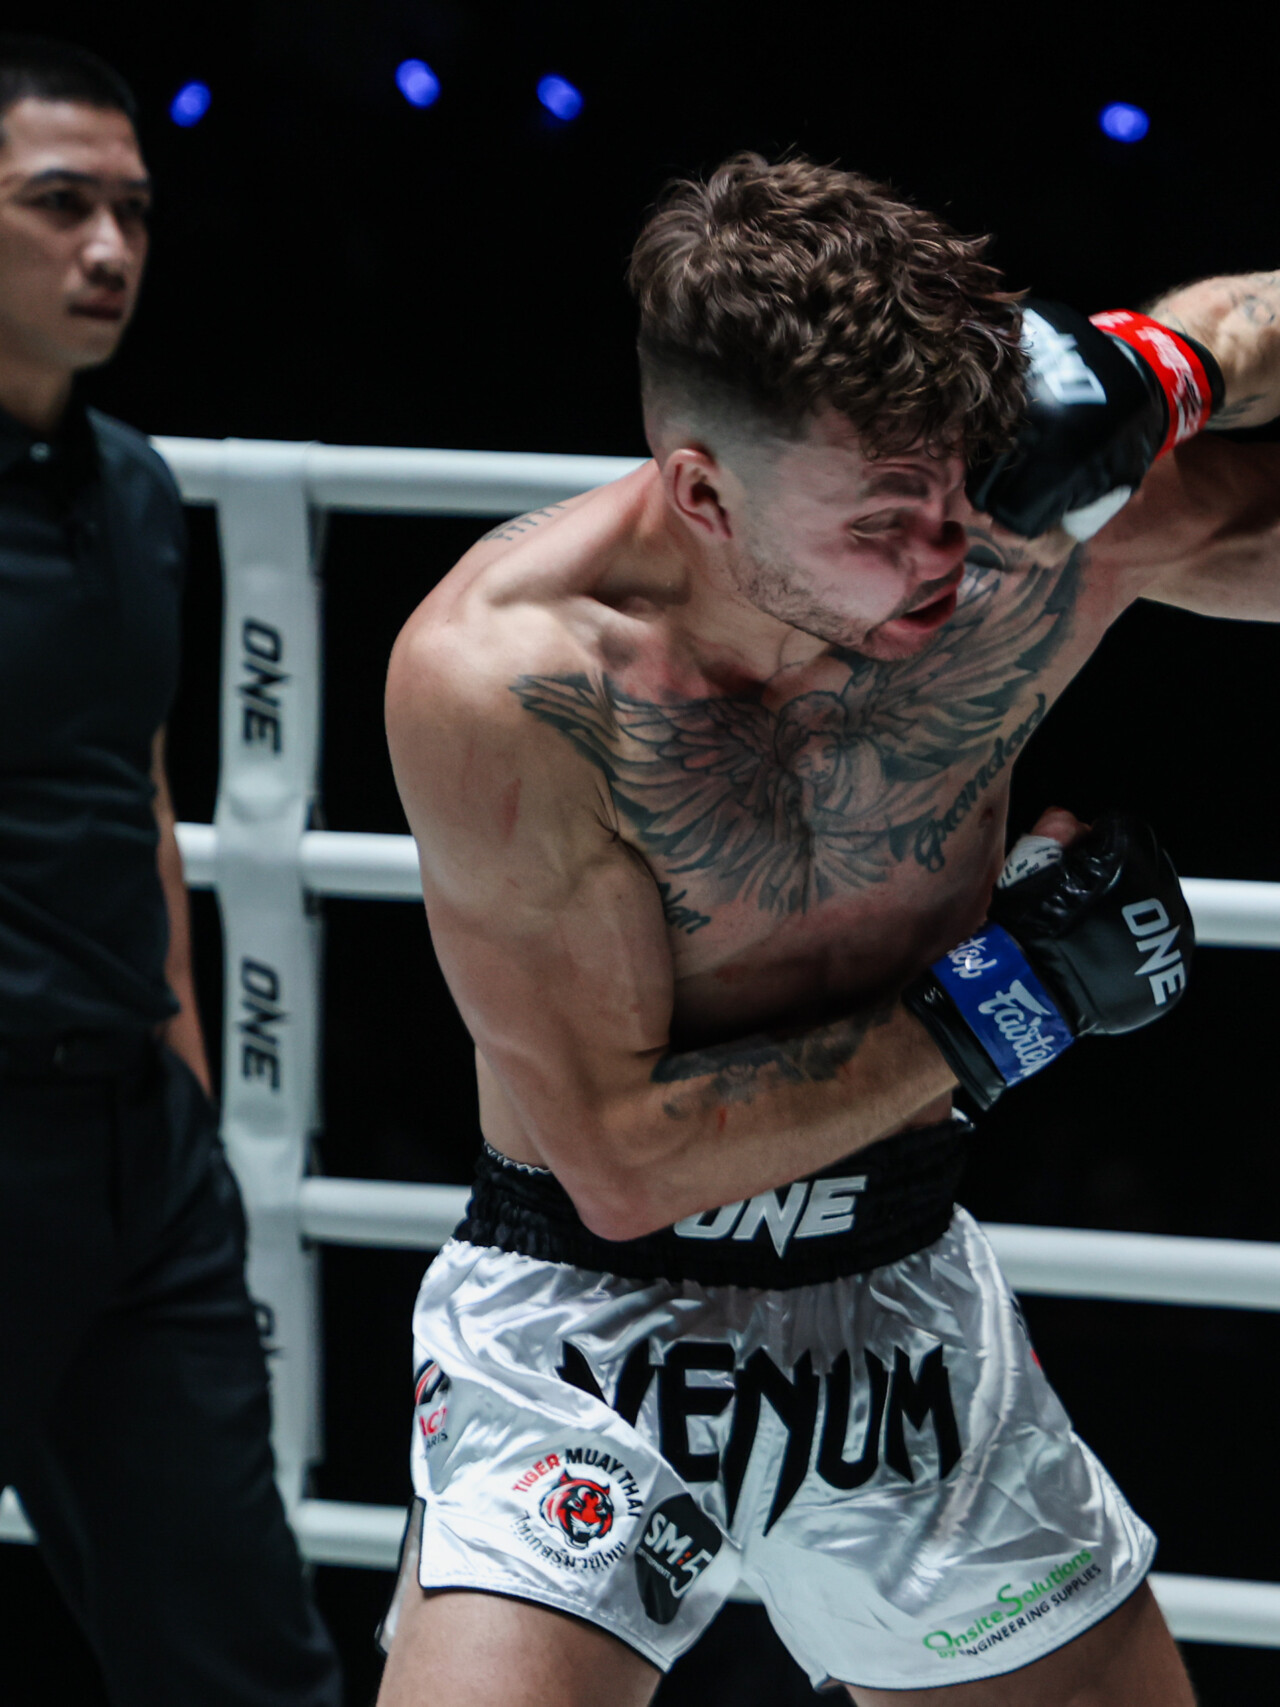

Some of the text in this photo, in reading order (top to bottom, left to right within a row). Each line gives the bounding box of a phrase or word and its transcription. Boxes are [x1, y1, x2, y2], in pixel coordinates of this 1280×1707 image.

[238, 617, 290, 753] ONE
[1121, 898, 1186, 1006] ONE
[237, 956, 289, 1090] ONE
[674, 1176, 867, 1258] ONE
[513, 1447, 643, 1518] TIGER MUAY THAI
[555, 1338, 962, 1538] VENUM
[1050, 1563, 1102, 1608] SUPPLIES
